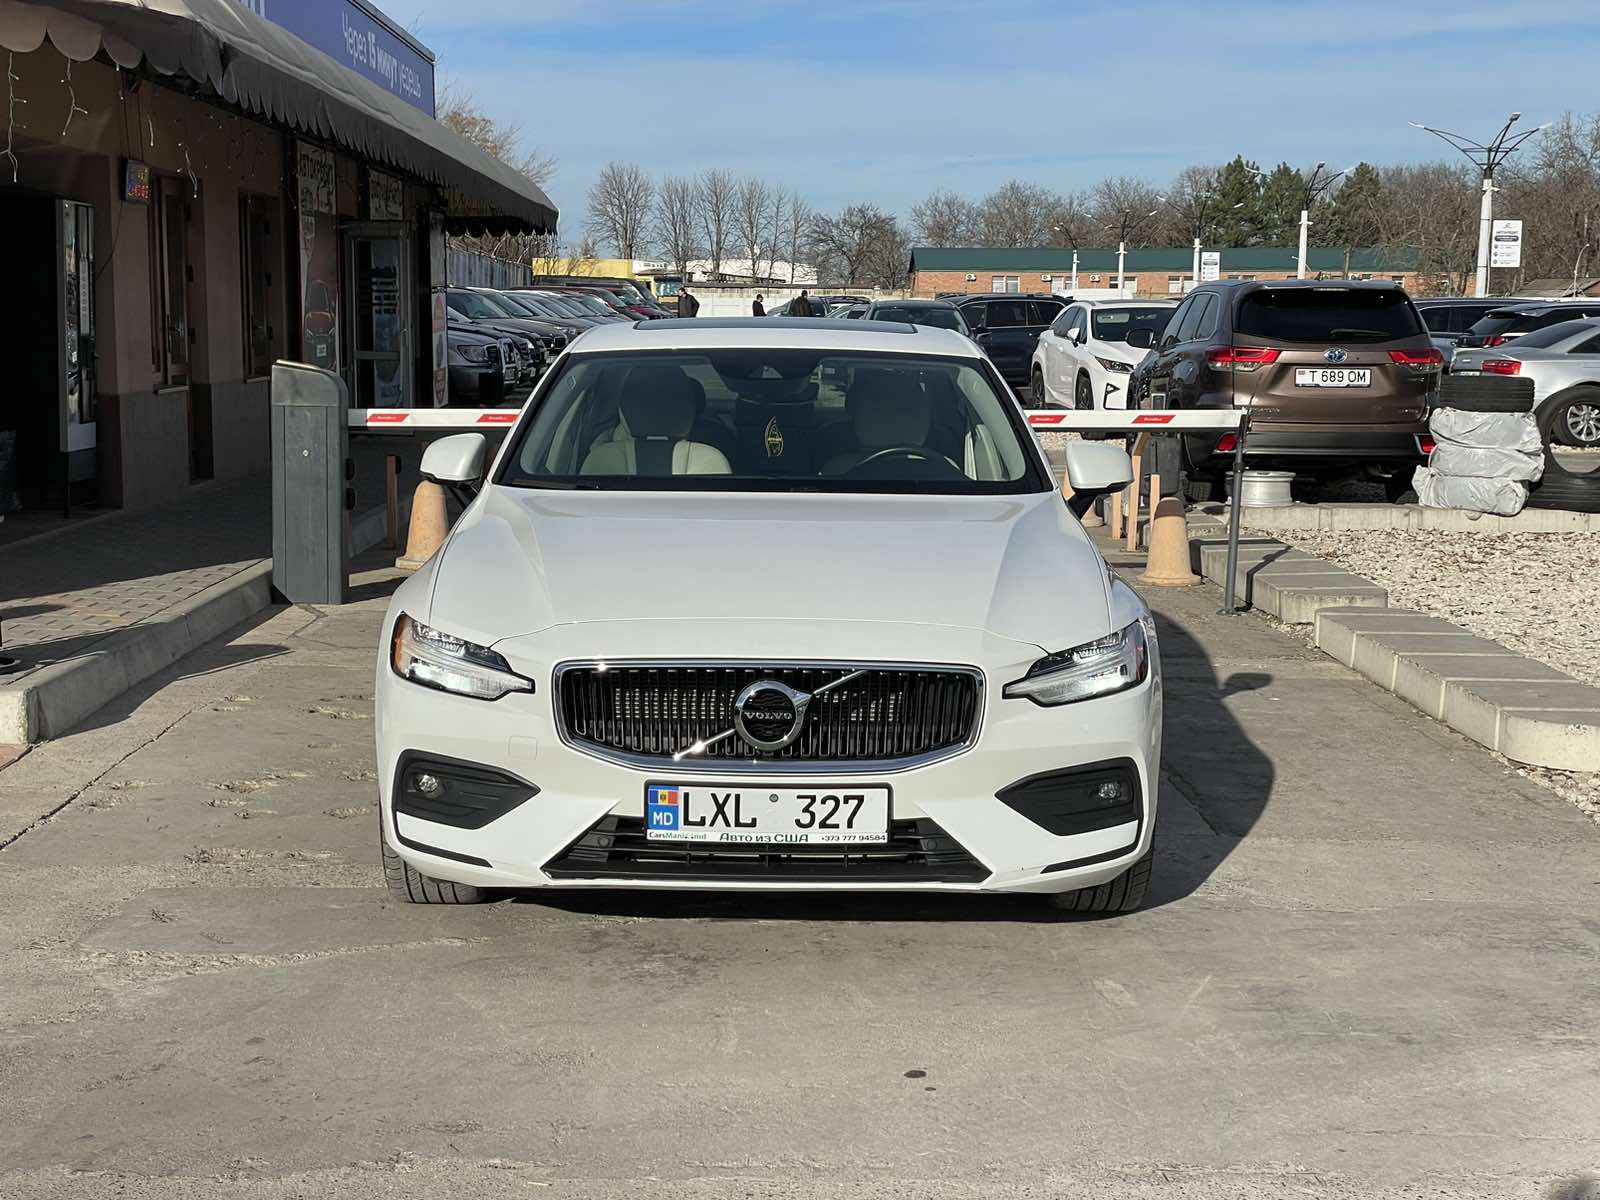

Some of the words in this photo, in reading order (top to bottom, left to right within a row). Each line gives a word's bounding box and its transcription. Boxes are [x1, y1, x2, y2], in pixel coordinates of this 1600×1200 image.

[342, 11, 367, 66] Через
[367, 31, 376, 69] 15
[1309, 370, 1318, 382] T
[1321, 370, 1344, 383] 689
[1348, 370, 1366, 383] OM
[683, 791, 757, 828] LXL
[795, 794, 865, 829] 327
[653, 811, 673, 825] MD
[720, 832, 753, 842] Авто
[755, 834, 772, 842] из
[774, 833, 808, 842] США
